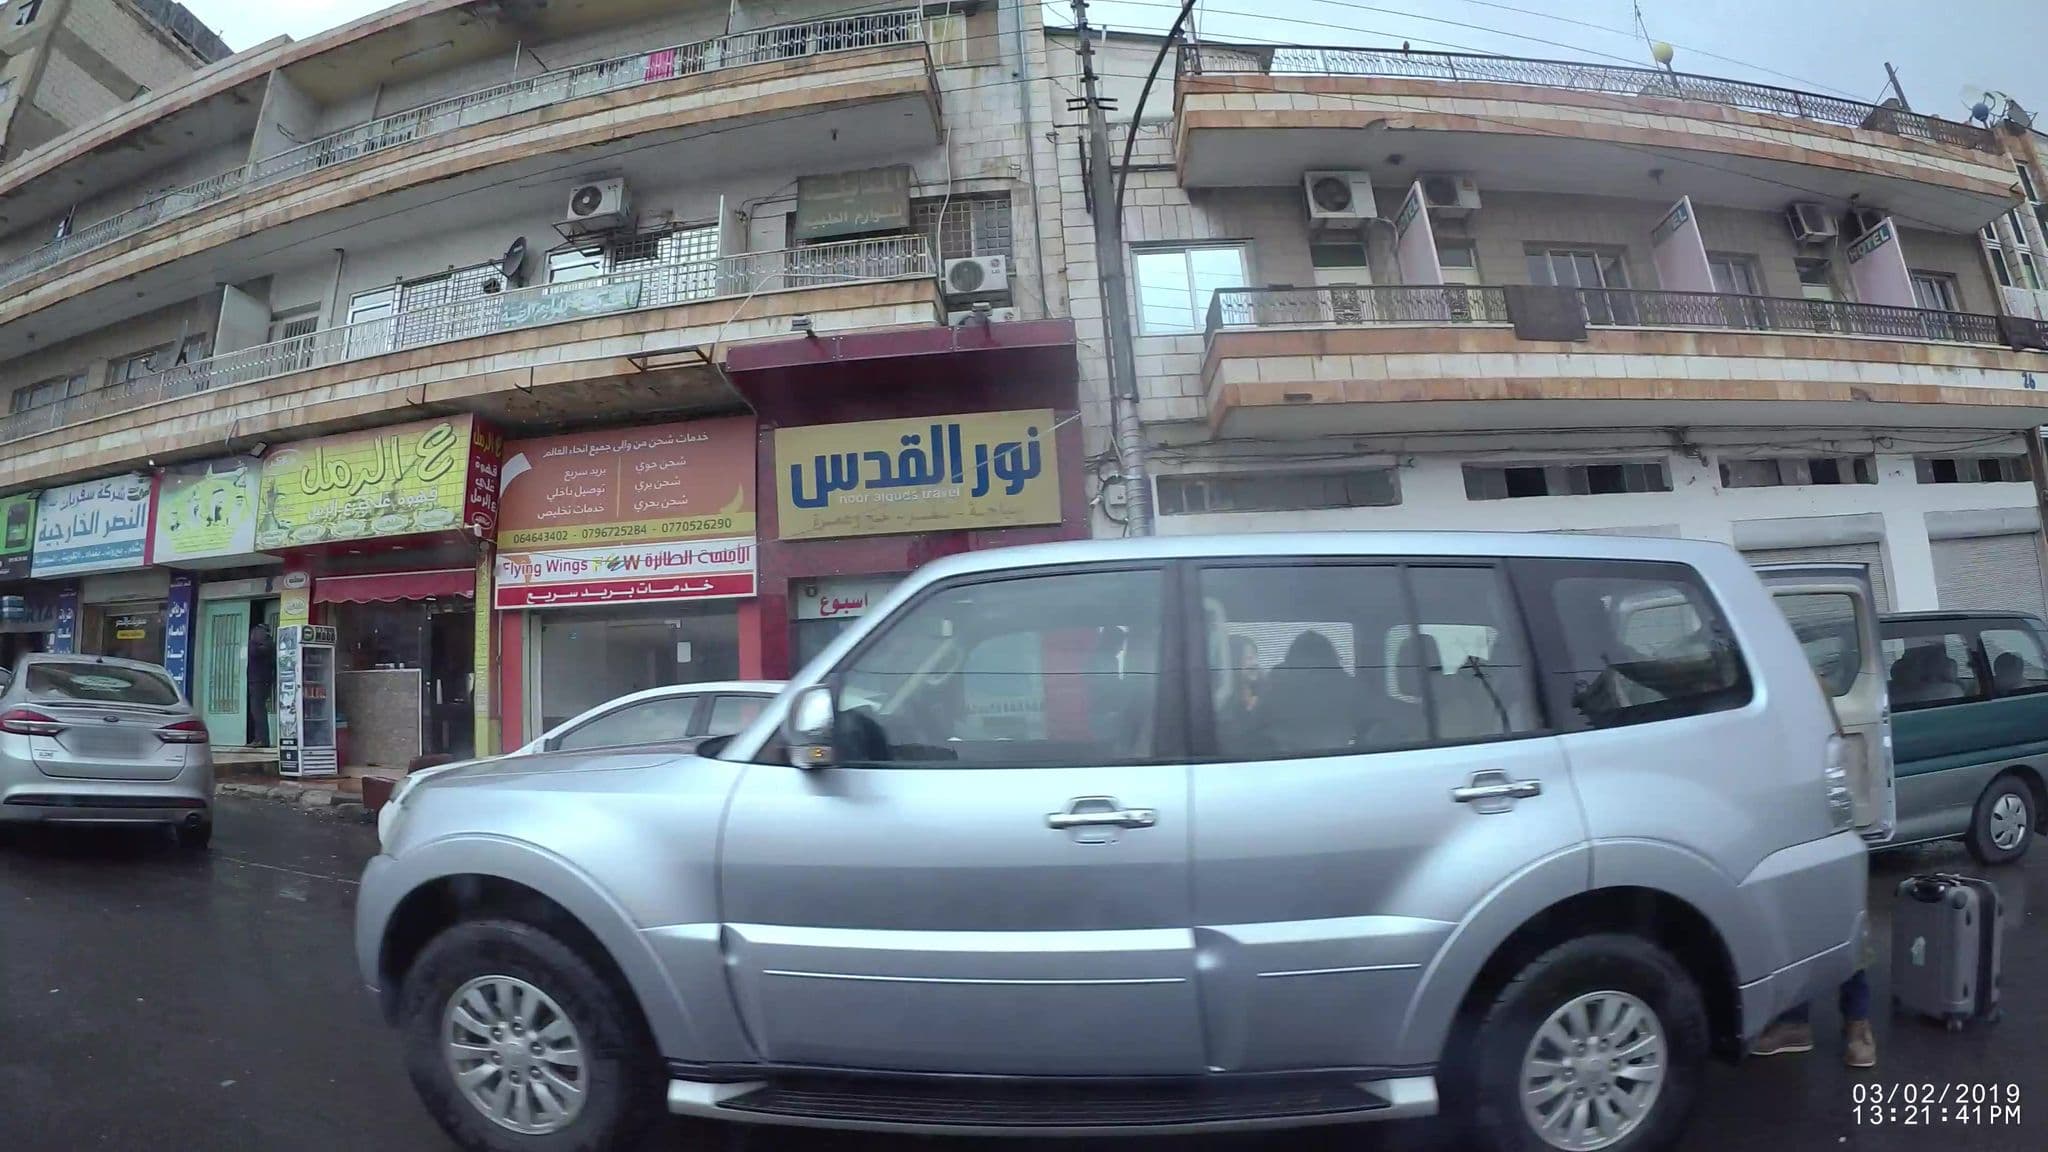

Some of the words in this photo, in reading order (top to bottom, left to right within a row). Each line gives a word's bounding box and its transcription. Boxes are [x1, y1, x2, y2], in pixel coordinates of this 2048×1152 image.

[633, 440, 648, 450] من
[649, 434, 674, 448] شحن
[676, 433, 709, 444] خدمات
[542, 446, 567, 458] العالم
[589, 444, 611, 457] جميع
[300, 434, 403, 496] الرمل
[659, 456, 686, 470] شحن
[790, 424, 963, 509] القدس
[971, 426, 1042, 497] نور
[564, 470, 588, 482] سريع
[590, 467, 607, 479] بريد
[575, 483, 606, 497] توصيل
[634, 481, 653, 492] بري
[654, 476, 681, 490] شحن
[98, 483, 126, 502] شركة
[546, 486, 573, 502] داخلي
[840, 493, 868, 504] noor
[573, 503, 605, 514] خدمات
[633, 500, 660, 513] بحري
[661, 495, 688, 509] شحن
[537, 504, 572, 520] تخليص
[103, 502, 147, 538] النصر
[38, 510, 101, 546] الخارجية
[513, 530, 568, 544] 064643402
[582, 525, 647, 539] 0796725284
[661, 518, 732, 533] 0770526290
[503, 562, 542, 579] Flying
[546, 559, 588, 575] Wings
[580, 586, 634, 600] بريد
[636, 579, 714, 595] خدمات
[527, 591, 578, 604] سريع
